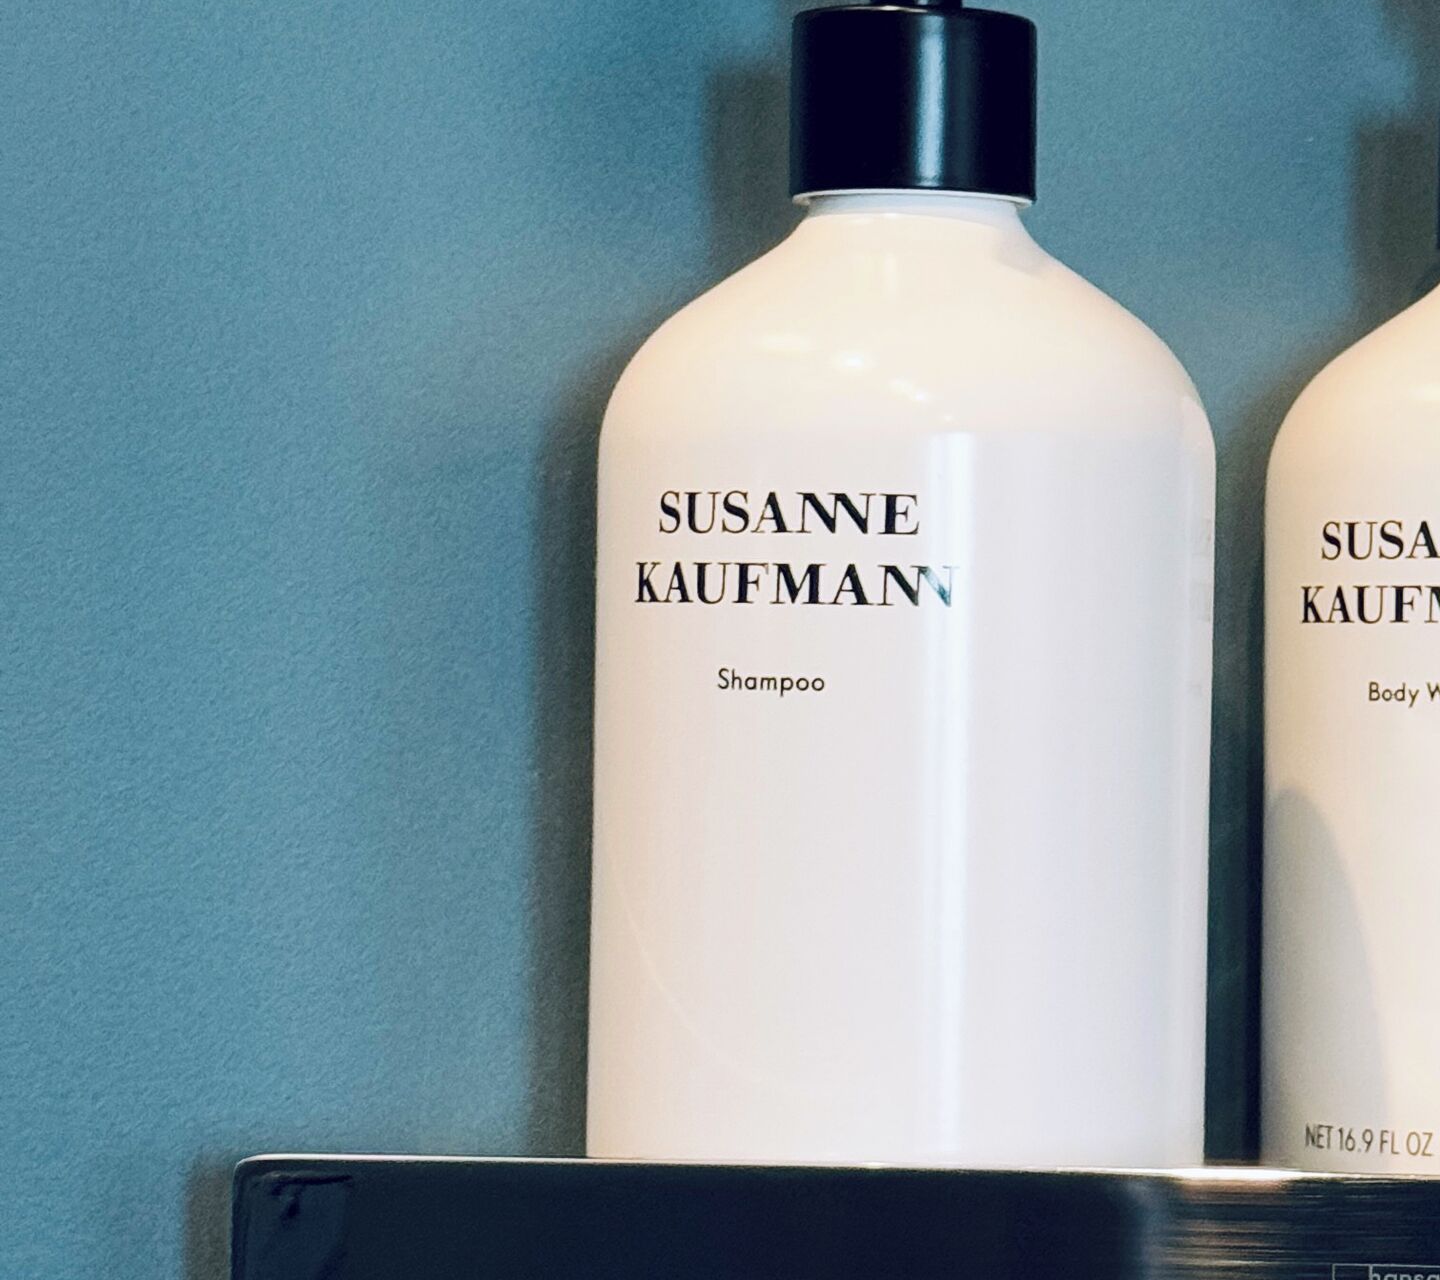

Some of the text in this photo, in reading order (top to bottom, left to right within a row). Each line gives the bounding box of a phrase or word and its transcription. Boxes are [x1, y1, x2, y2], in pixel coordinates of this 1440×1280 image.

[659, 491, 920, 535] SUSANNE
[635, 562, 959, 607] KAUFMANN
[717, 668, 825, 697] Shampoo
[1369, 681, 1420, 708] Body
[1305, 1123, 1333, 1150] NET
[1338, 1128, 1374, 1153] 16.9
[1379, 1130, 1399, 1155] FL
[1406, 1131, 1434, 1157] OZ
